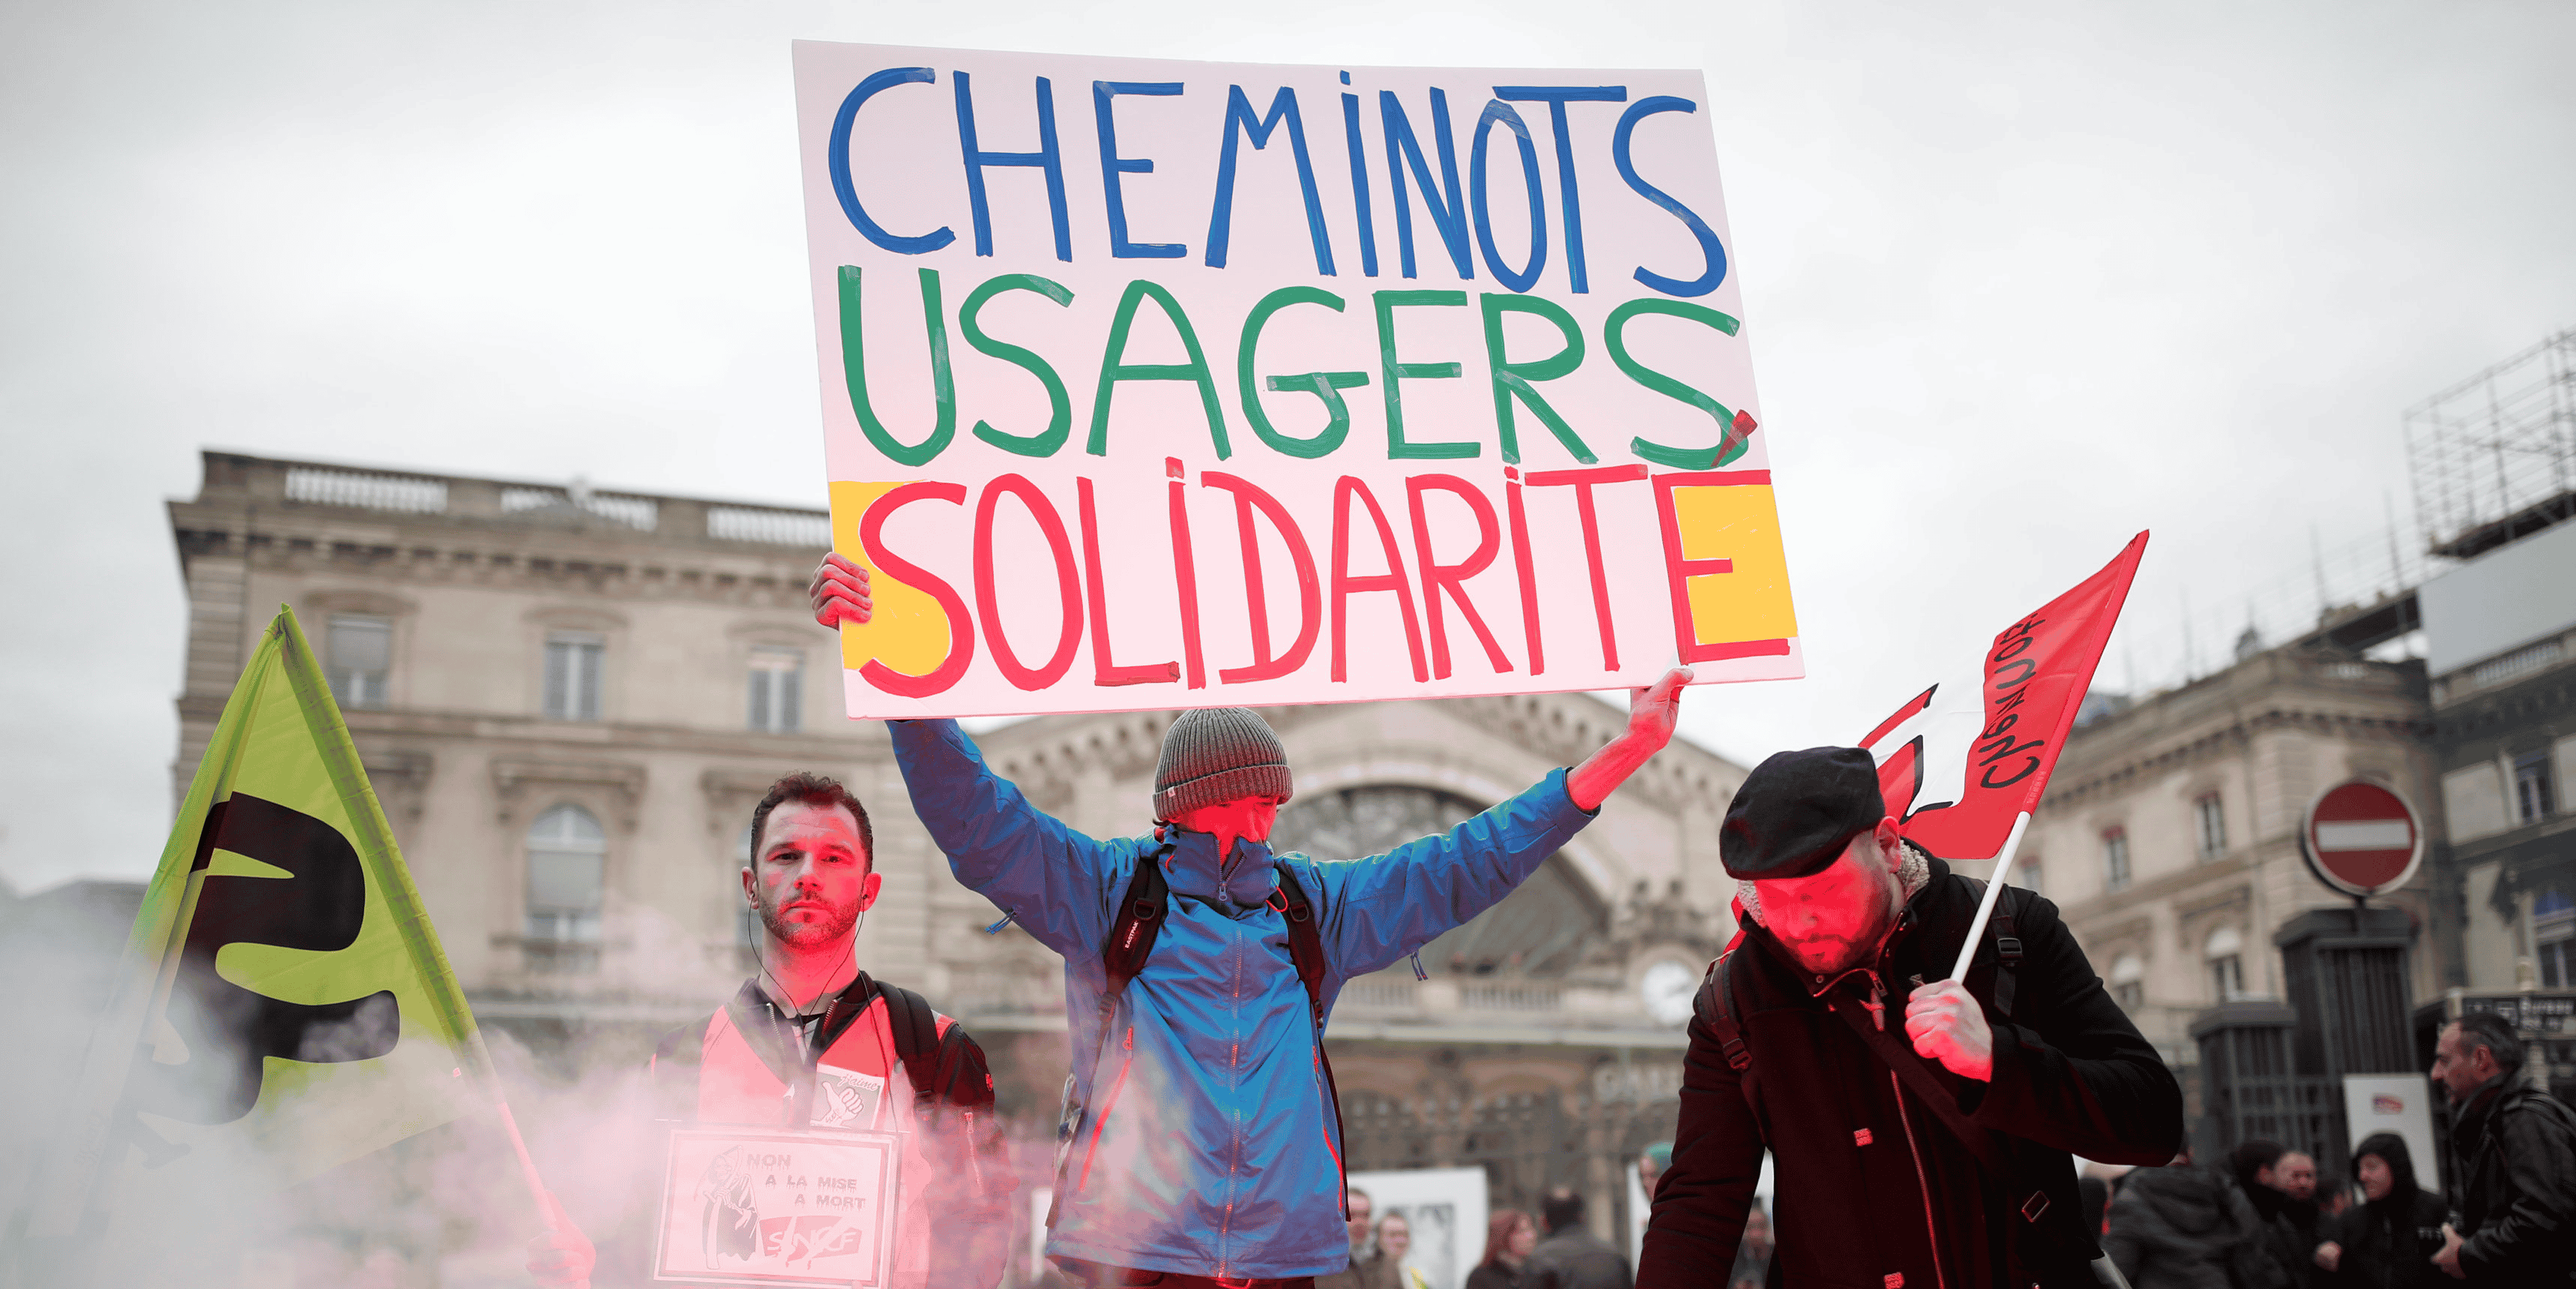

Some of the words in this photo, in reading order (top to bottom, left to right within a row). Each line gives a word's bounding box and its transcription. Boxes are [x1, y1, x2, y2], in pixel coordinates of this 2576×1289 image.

[837, 265, 1749, 468] USAGERS
[1124, 920, 1139, 949] EASTPAK
[746, 1153, 791, 1171] NON
[765, 1174, 776, 1188] A
[786, 1174, 807, 1189] LA
[817, 1176, 857, 1192] MISE
[794, 1193, 806, 1207] A
[816, 1194, 866, 1210] MORT
